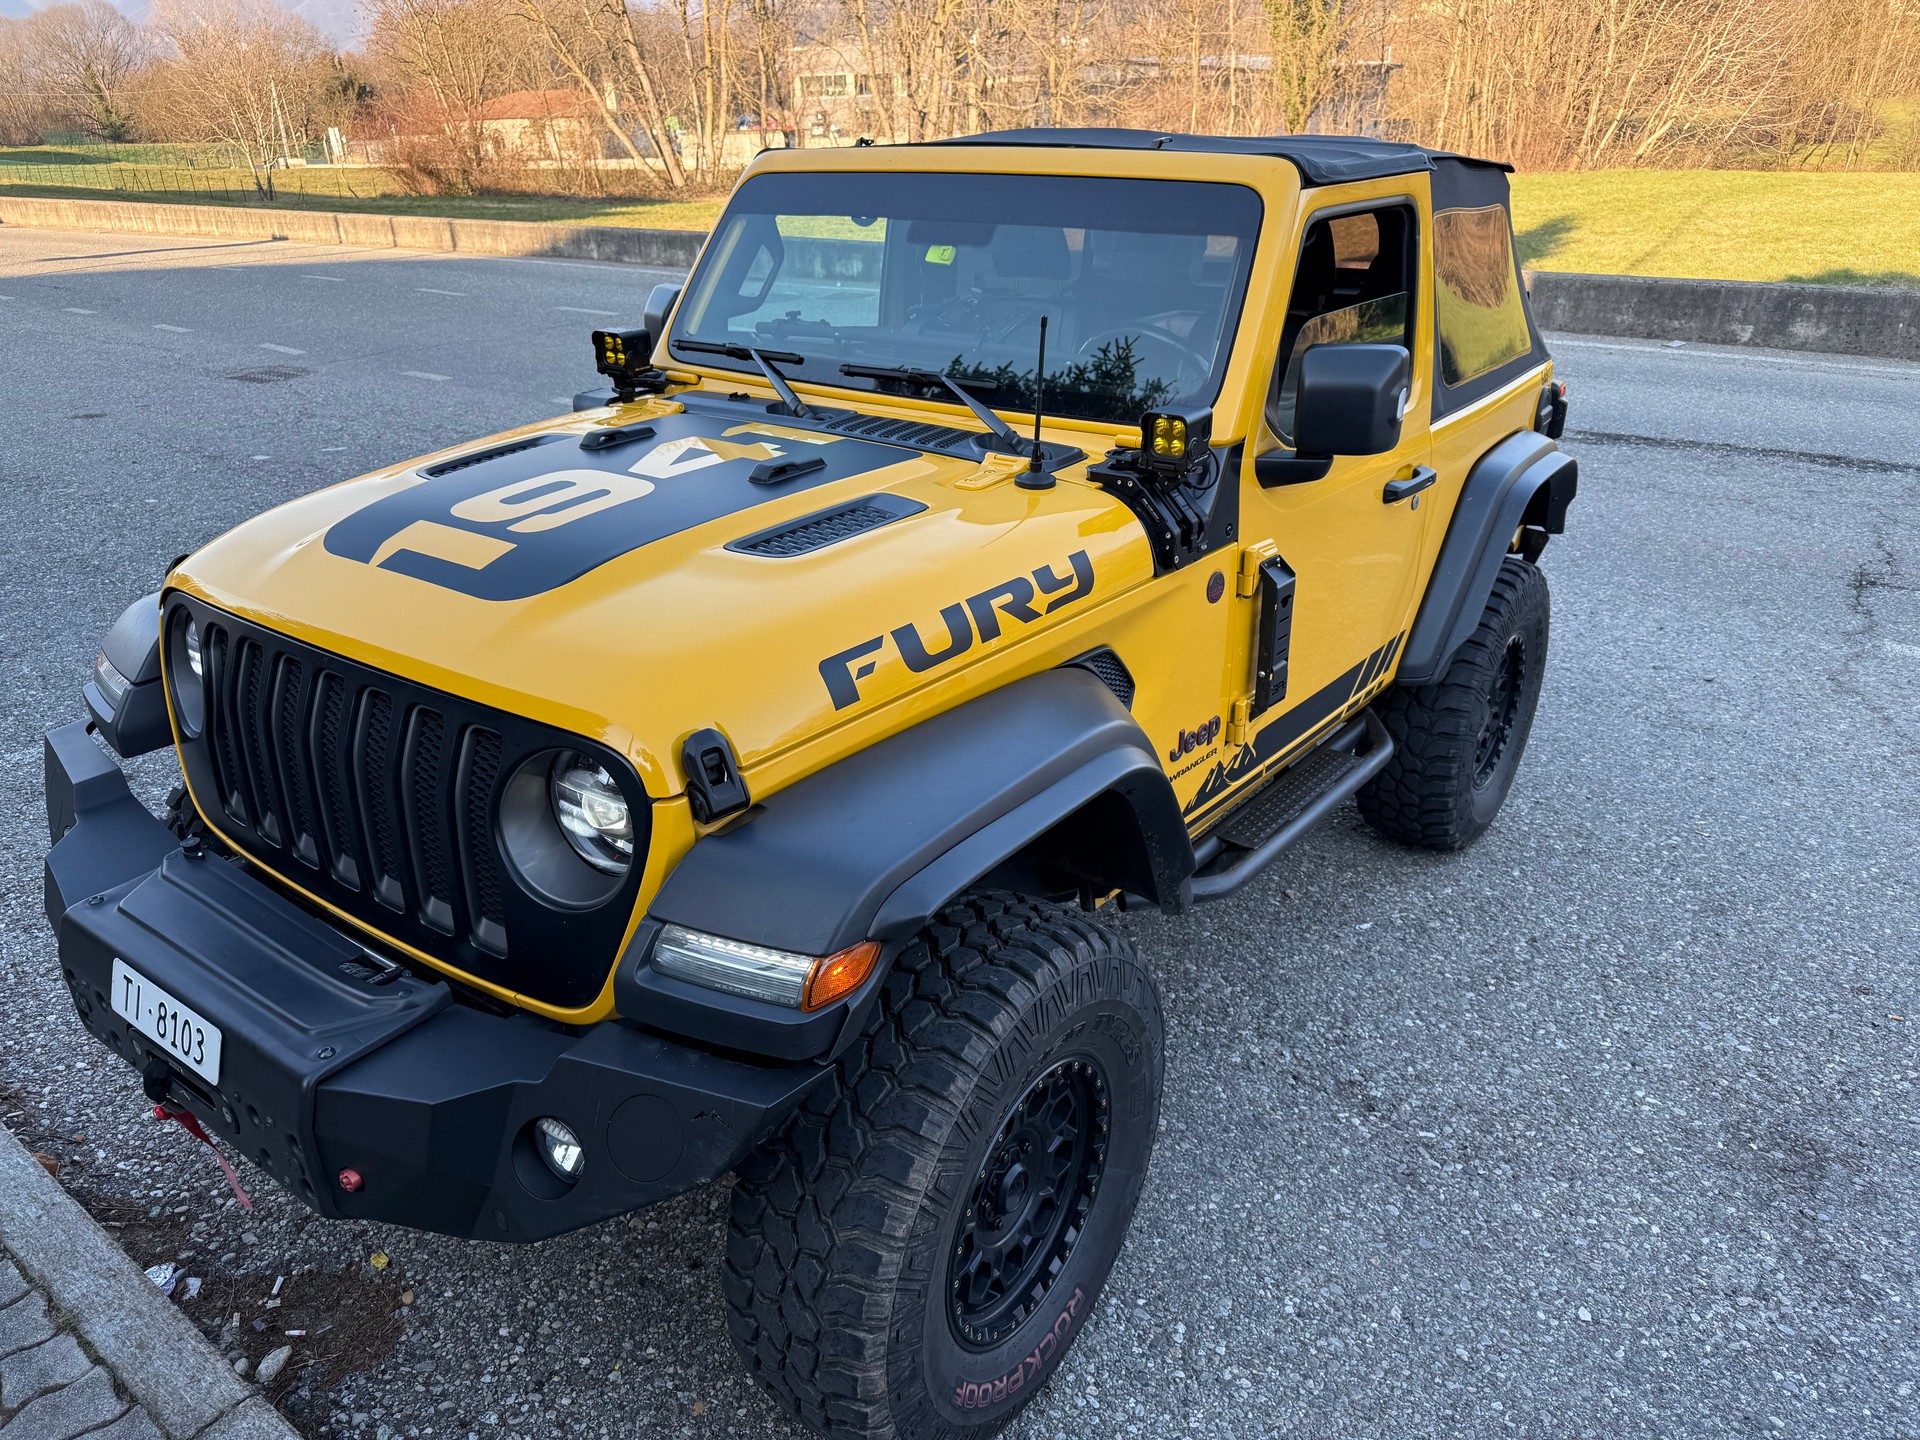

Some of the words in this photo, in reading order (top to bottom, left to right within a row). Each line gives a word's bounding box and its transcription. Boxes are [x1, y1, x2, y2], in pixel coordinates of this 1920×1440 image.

[368, 422, 846, 570] 1941
[818, 549, 1095, 712] FURY
[1168, 747, 1218, 783] WRANGLER
[1169, 715, 1222, 763] Jeep
[1093, 1012, 1142, 1066] TYRES
[951, 1286, 1086, 1409] ROCKPROOF
